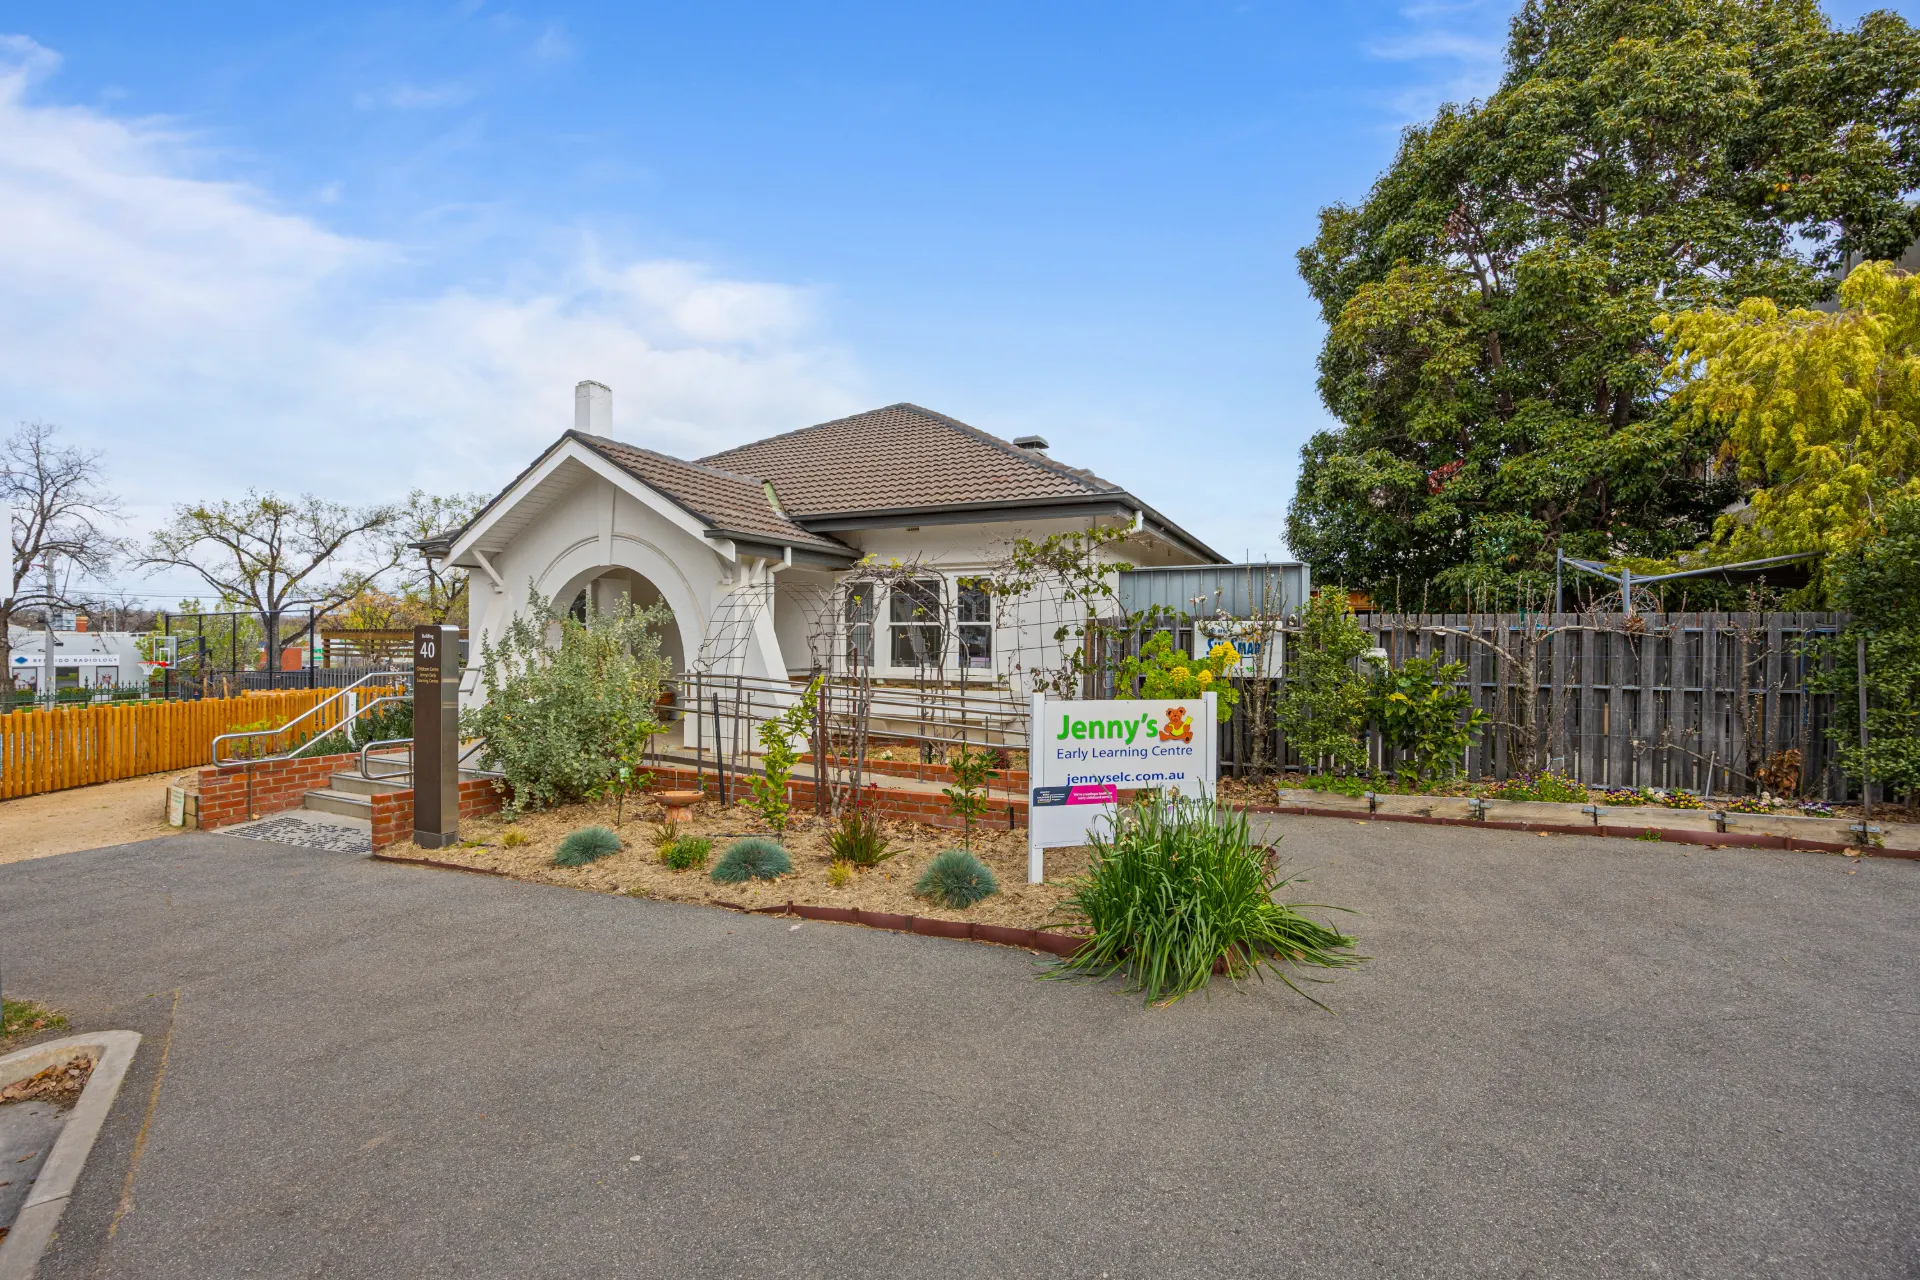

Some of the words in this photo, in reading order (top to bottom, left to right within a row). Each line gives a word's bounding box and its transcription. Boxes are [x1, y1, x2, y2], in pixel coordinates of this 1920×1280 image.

[420, 641, 435, 658] 40
[1056, 713, 1158, 745] Jenny's
[1057, 748, 1088, 761] Early
[1092, 746, 1148, 759] Learning
[1152, 745, 1193, 756] Centre
[1066, 771, 1185, 786] jennyselc.com.au
